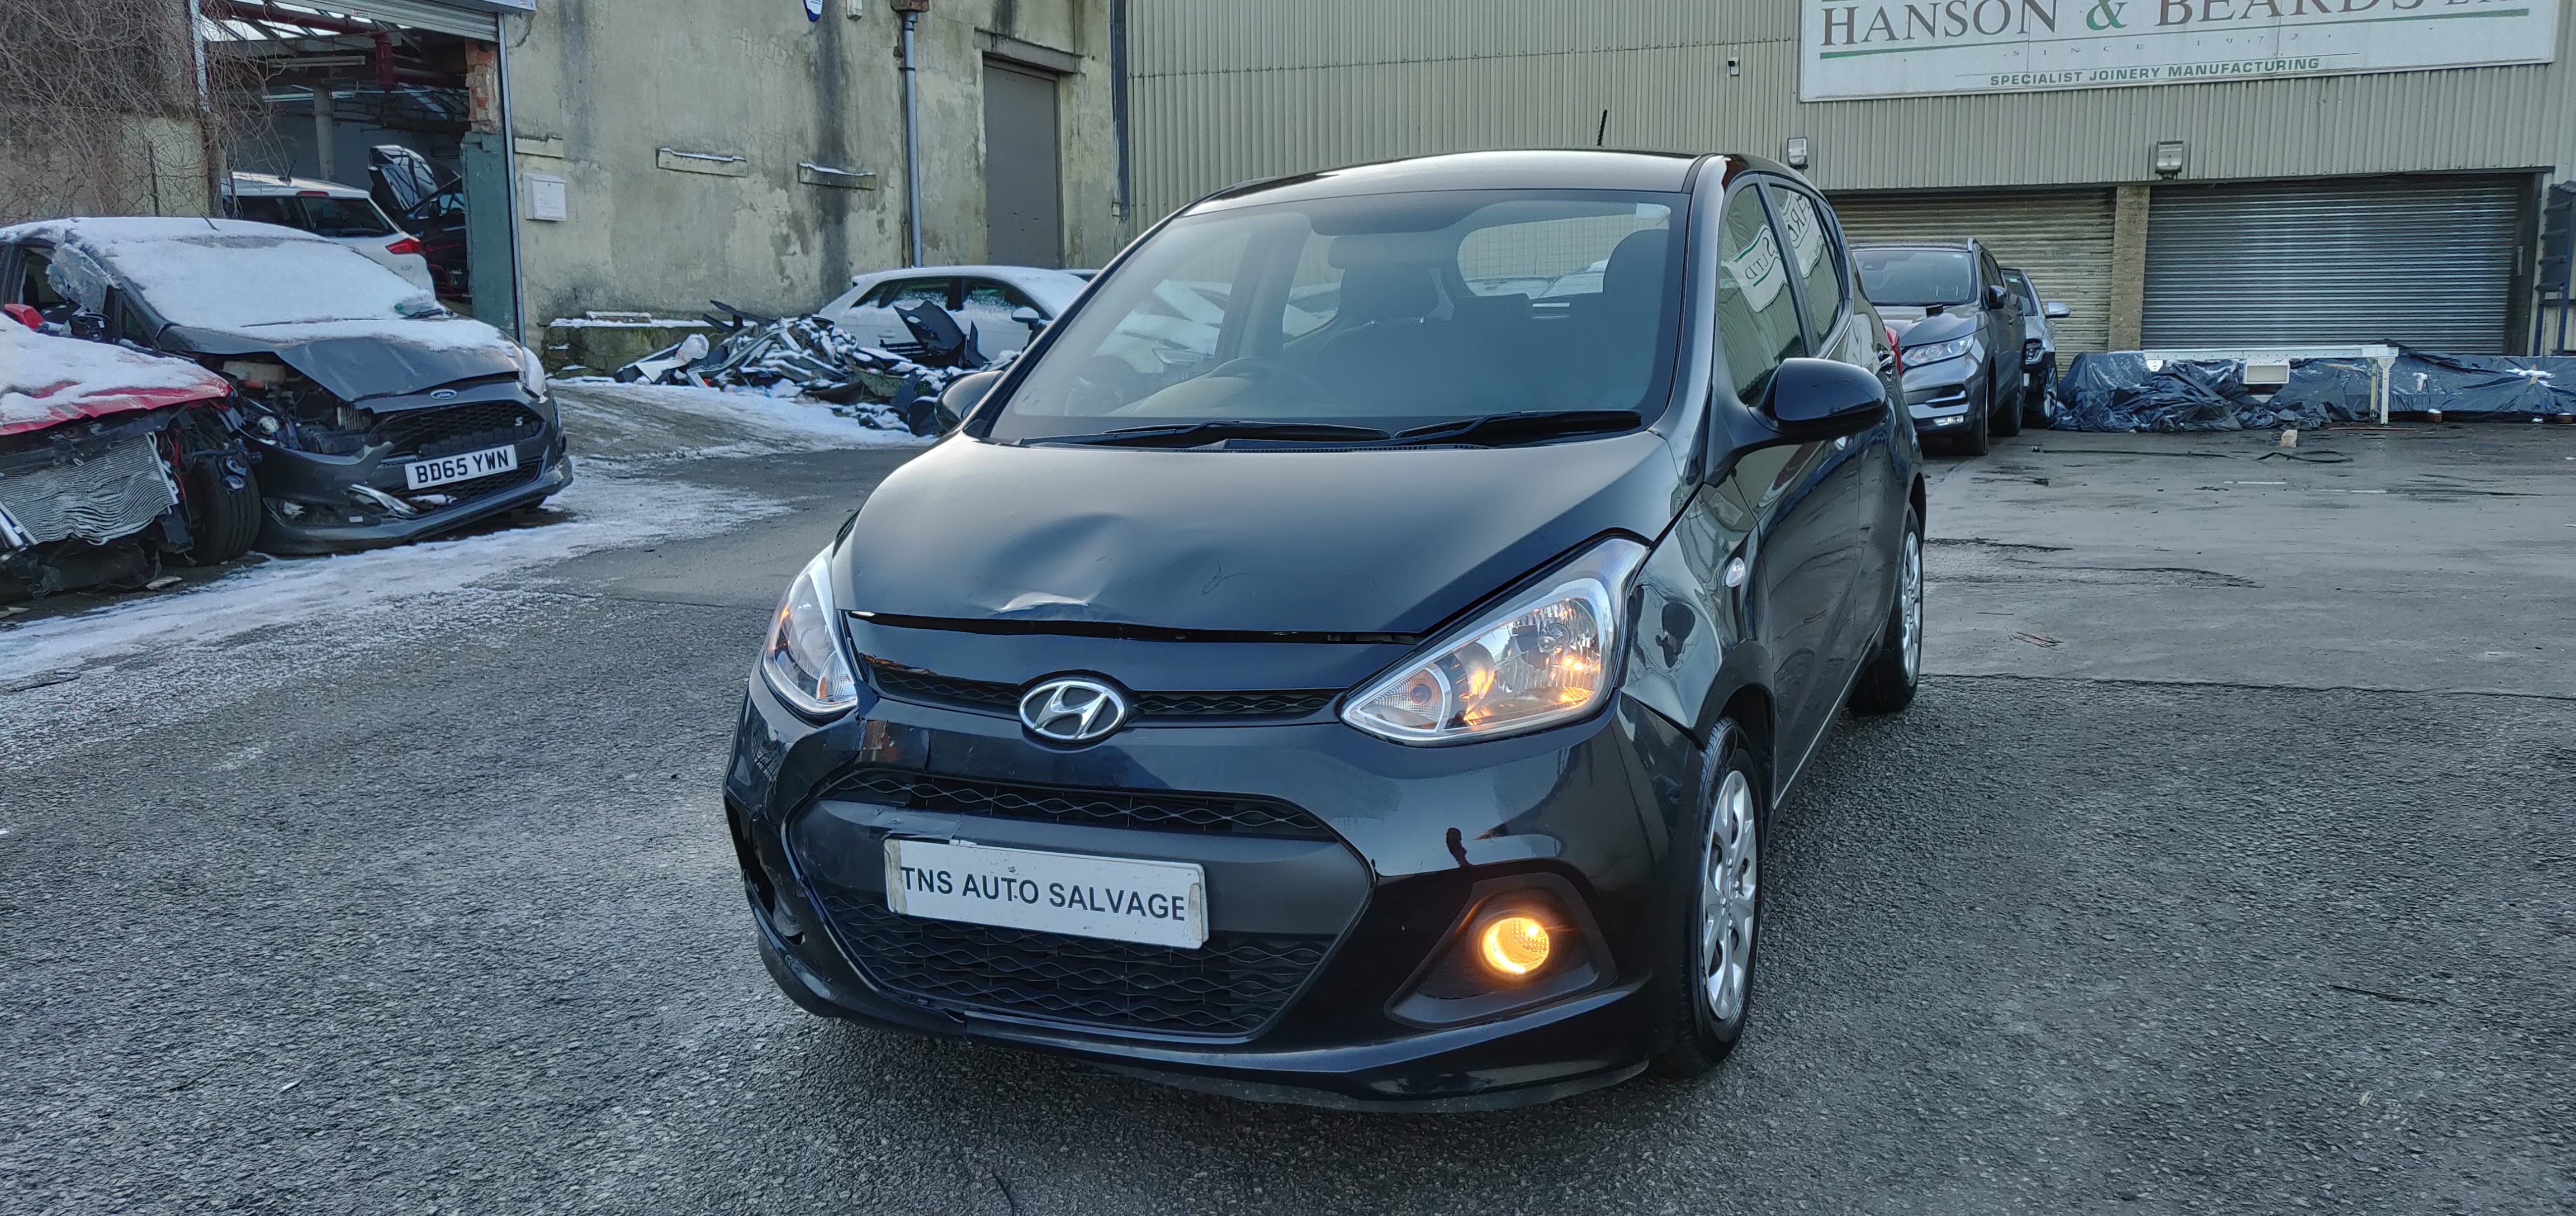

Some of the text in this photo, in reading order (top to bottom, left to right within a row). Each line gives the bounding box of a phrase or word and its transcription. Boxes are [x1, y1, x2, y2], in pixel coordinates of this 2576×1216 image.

[1821, 0, 2425, 46] HANSON & BEA
[1990, 58, 2320, 86] SPECIALIST JOINERY MANUFACTURING
[415, 449, 509, 484] BD65 YWN
[900, 866, 1185, 922] TNS AUTO SALVAGE
